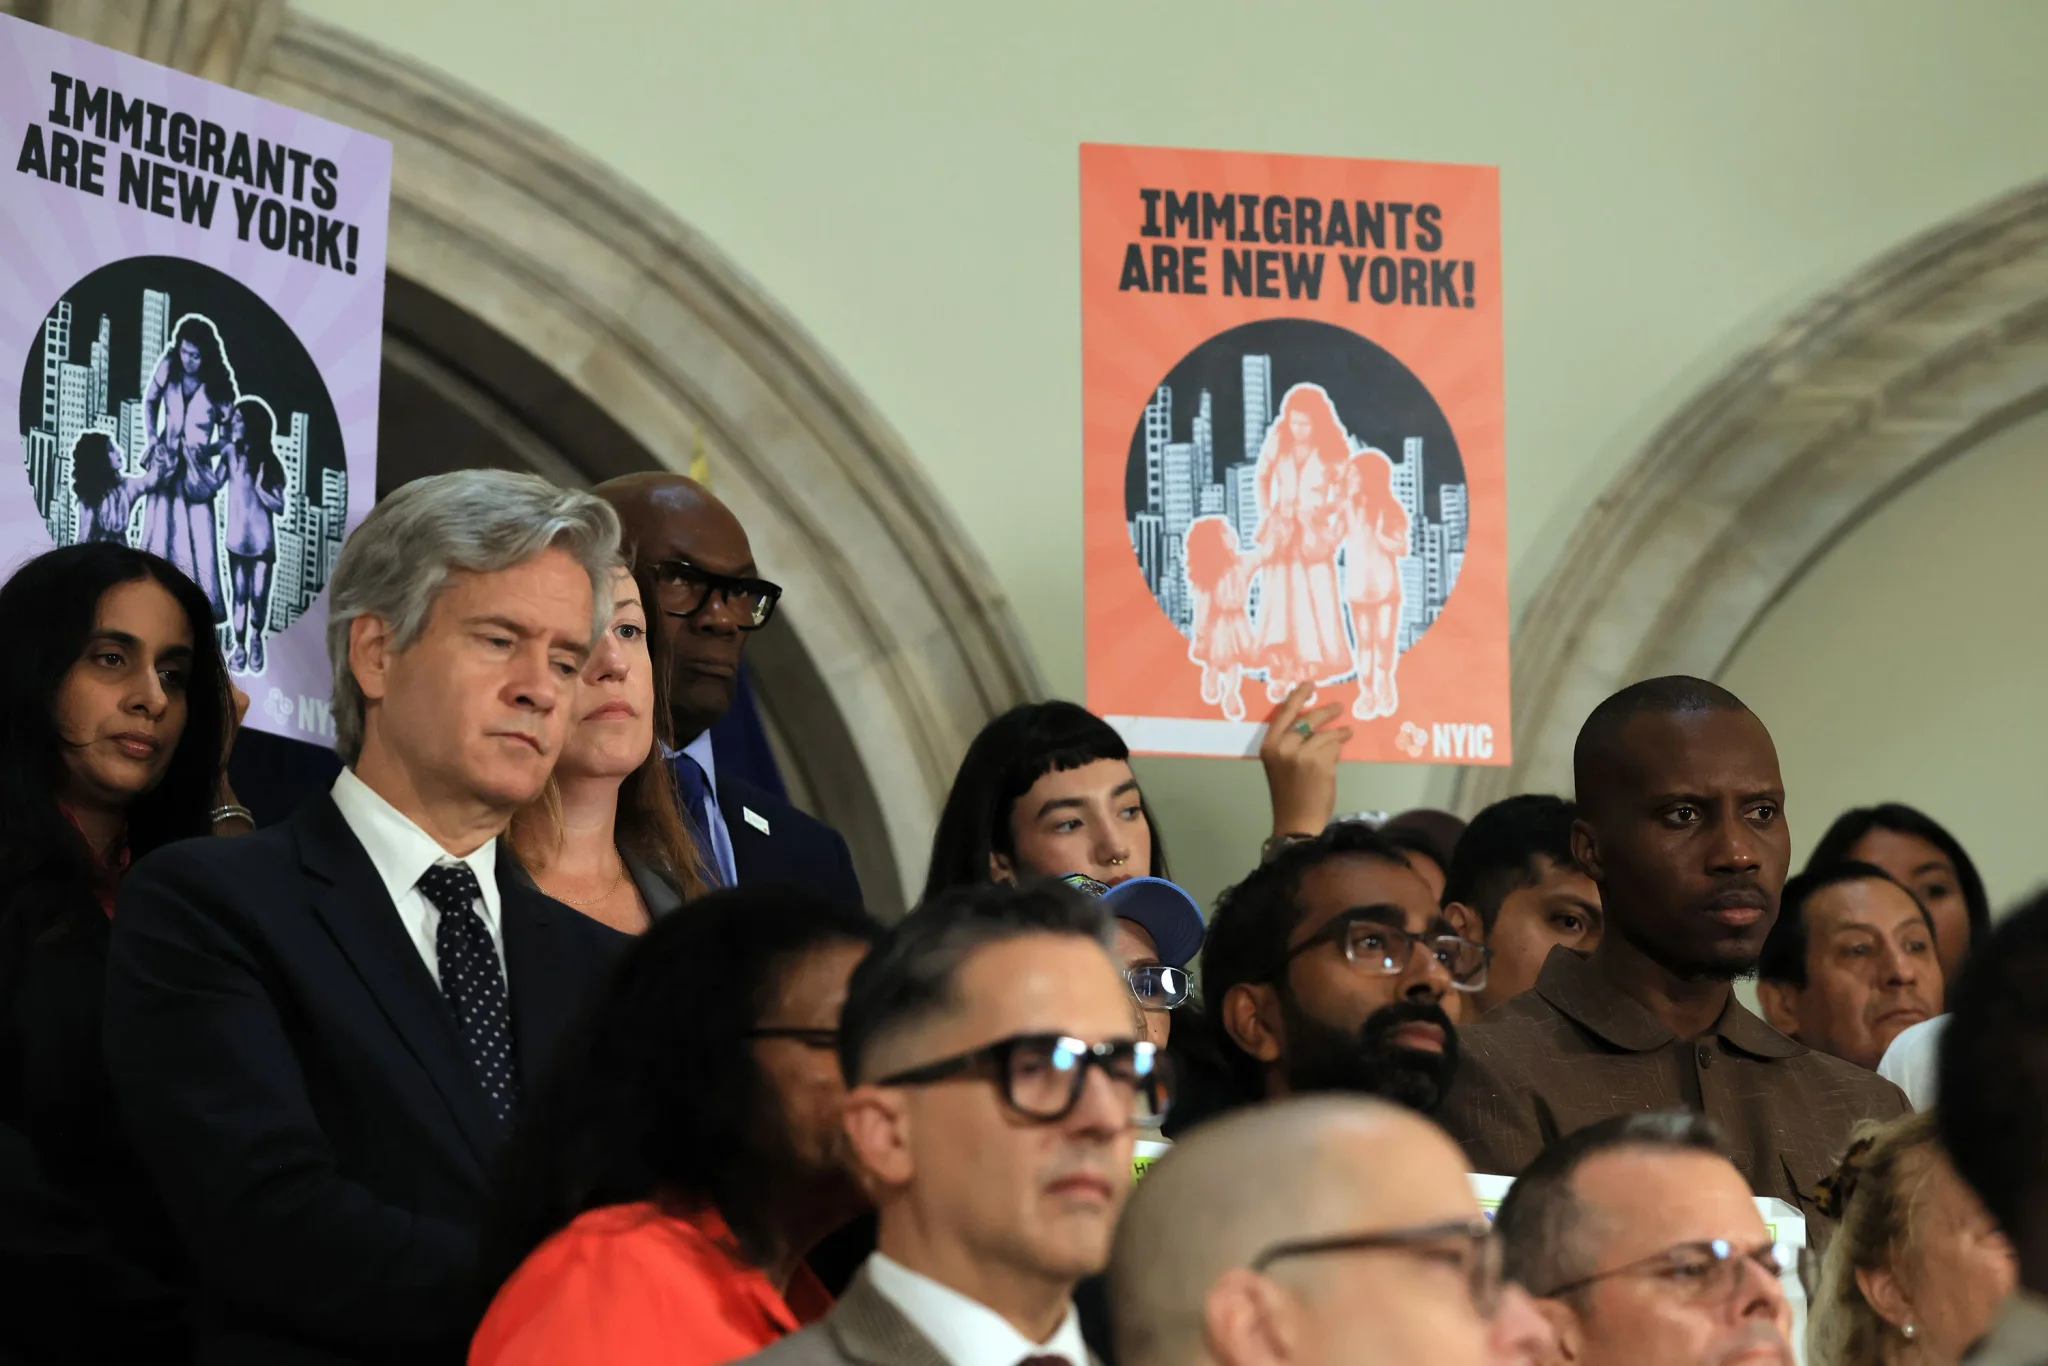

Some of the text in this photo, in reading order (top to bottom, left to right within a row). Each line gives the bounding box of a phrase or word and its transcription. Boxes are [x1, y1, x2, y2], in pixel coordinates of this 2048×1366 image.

[48, 71, 338, 211] IMMIGRANTS
[16, 123, 359, 276] ARE NEW YORK!
[1139, 188, 1442, 253] IMMIGRANTS
[1118, 242, 1475, 309] ARE NEW YORK!
[1432, 722, 1493, 758] NYIC
